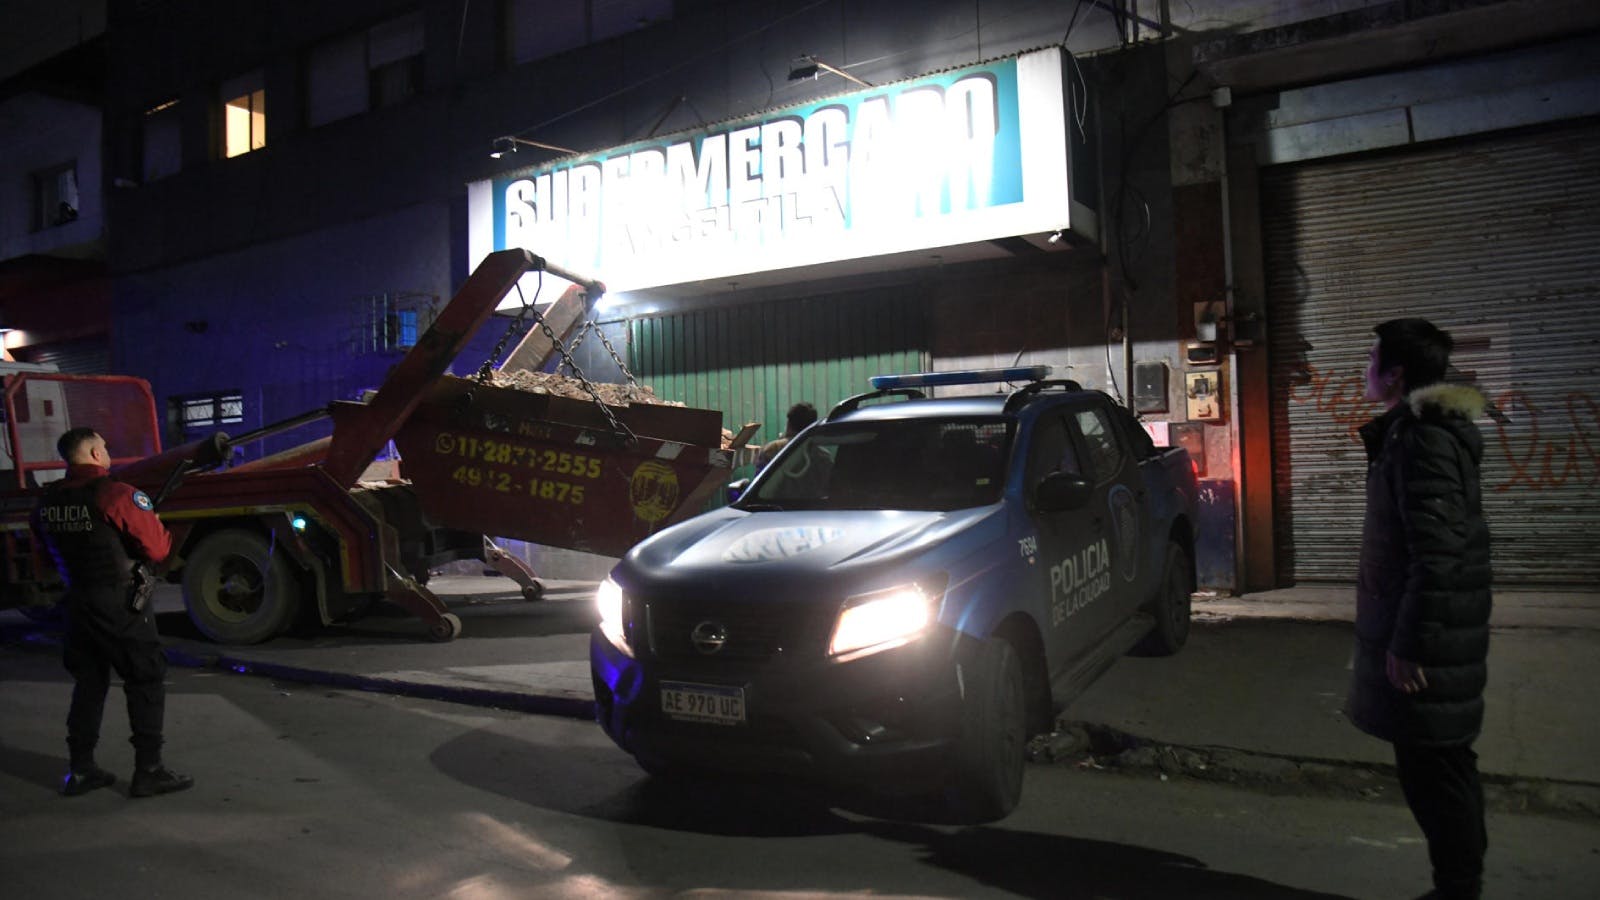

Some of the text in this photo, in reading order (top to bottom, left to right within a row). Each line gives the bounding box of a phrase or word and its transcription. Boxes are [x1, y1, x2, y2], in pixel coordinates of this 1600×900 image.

[504, 75, 998, 242] SUPERMERCADO
[39, 504, 91, 522] POLICIA
[1050, 538, 1110, 603] POLICIA
[1066, 592, 1080, 617] LA
[665, 692, 683, 711] AE
[687, 694, 716, 715] 970
